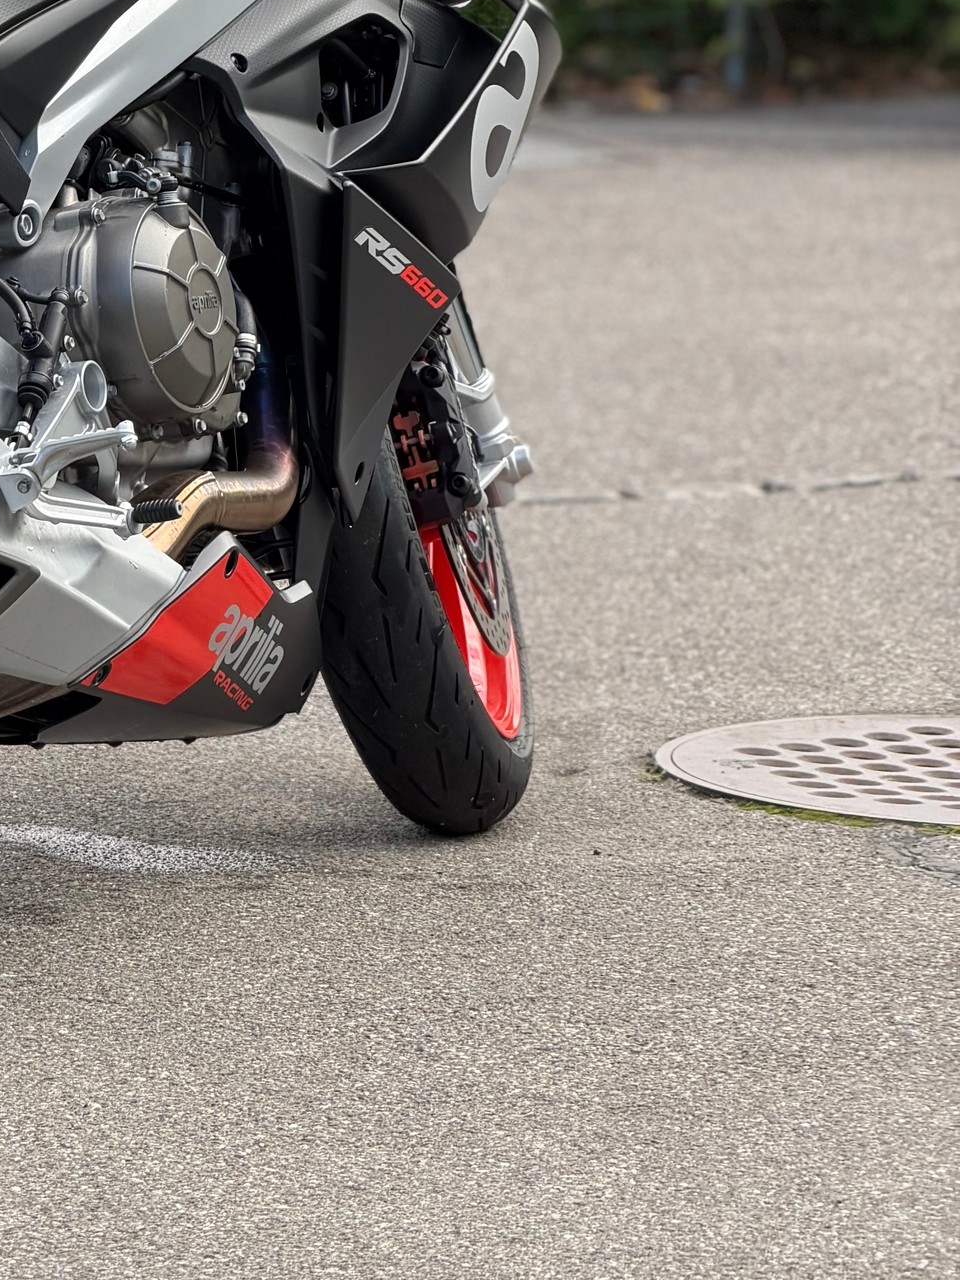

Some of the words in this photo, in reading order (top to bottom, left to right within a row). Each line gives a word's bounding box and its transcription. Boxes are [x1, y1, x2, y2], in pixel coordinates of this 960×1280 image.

[353, 226, 449, 309] RS660
[191, 290, 219, 314] aprilia
[208, 603, 285, 695] aprilia
[213, 670, 254, 711] RACING
